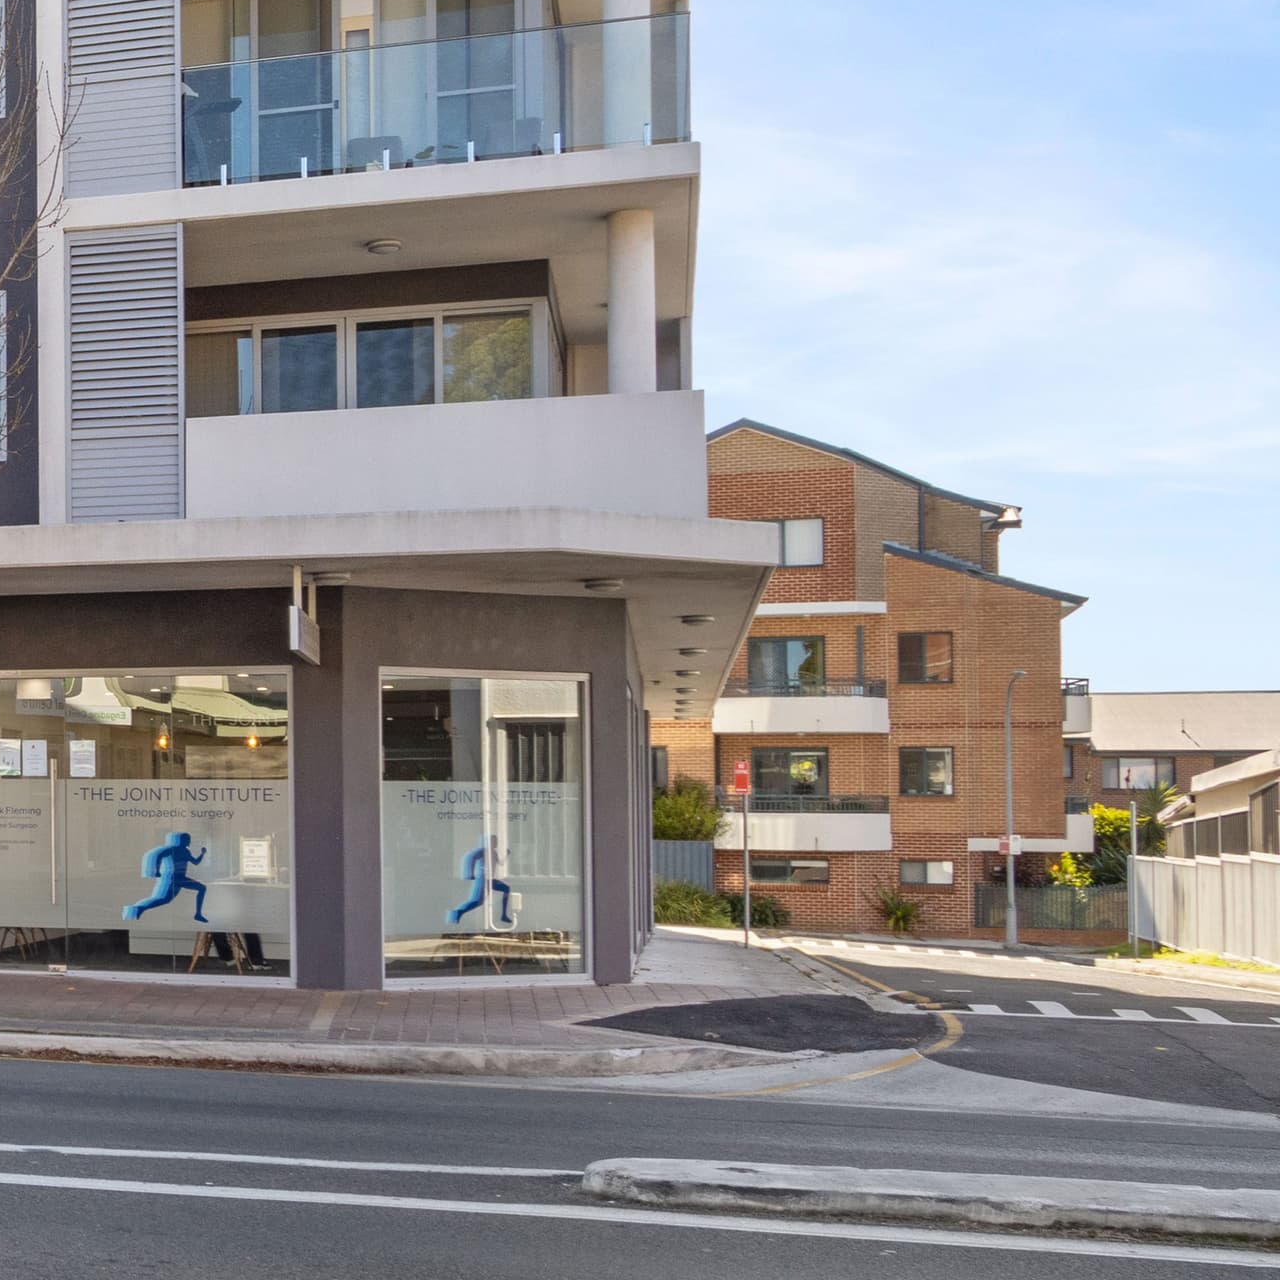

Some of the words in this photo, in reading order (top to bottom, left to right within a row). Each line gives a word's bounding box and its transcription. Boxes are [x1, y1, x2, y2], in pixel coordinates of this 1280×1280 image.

[120, 787, 173, 801] JOINT
[440, 789, 481, 803] JOINT
[117, 807, 186, 818] orthopaedic
[191, 808, 234, 819] surgery
